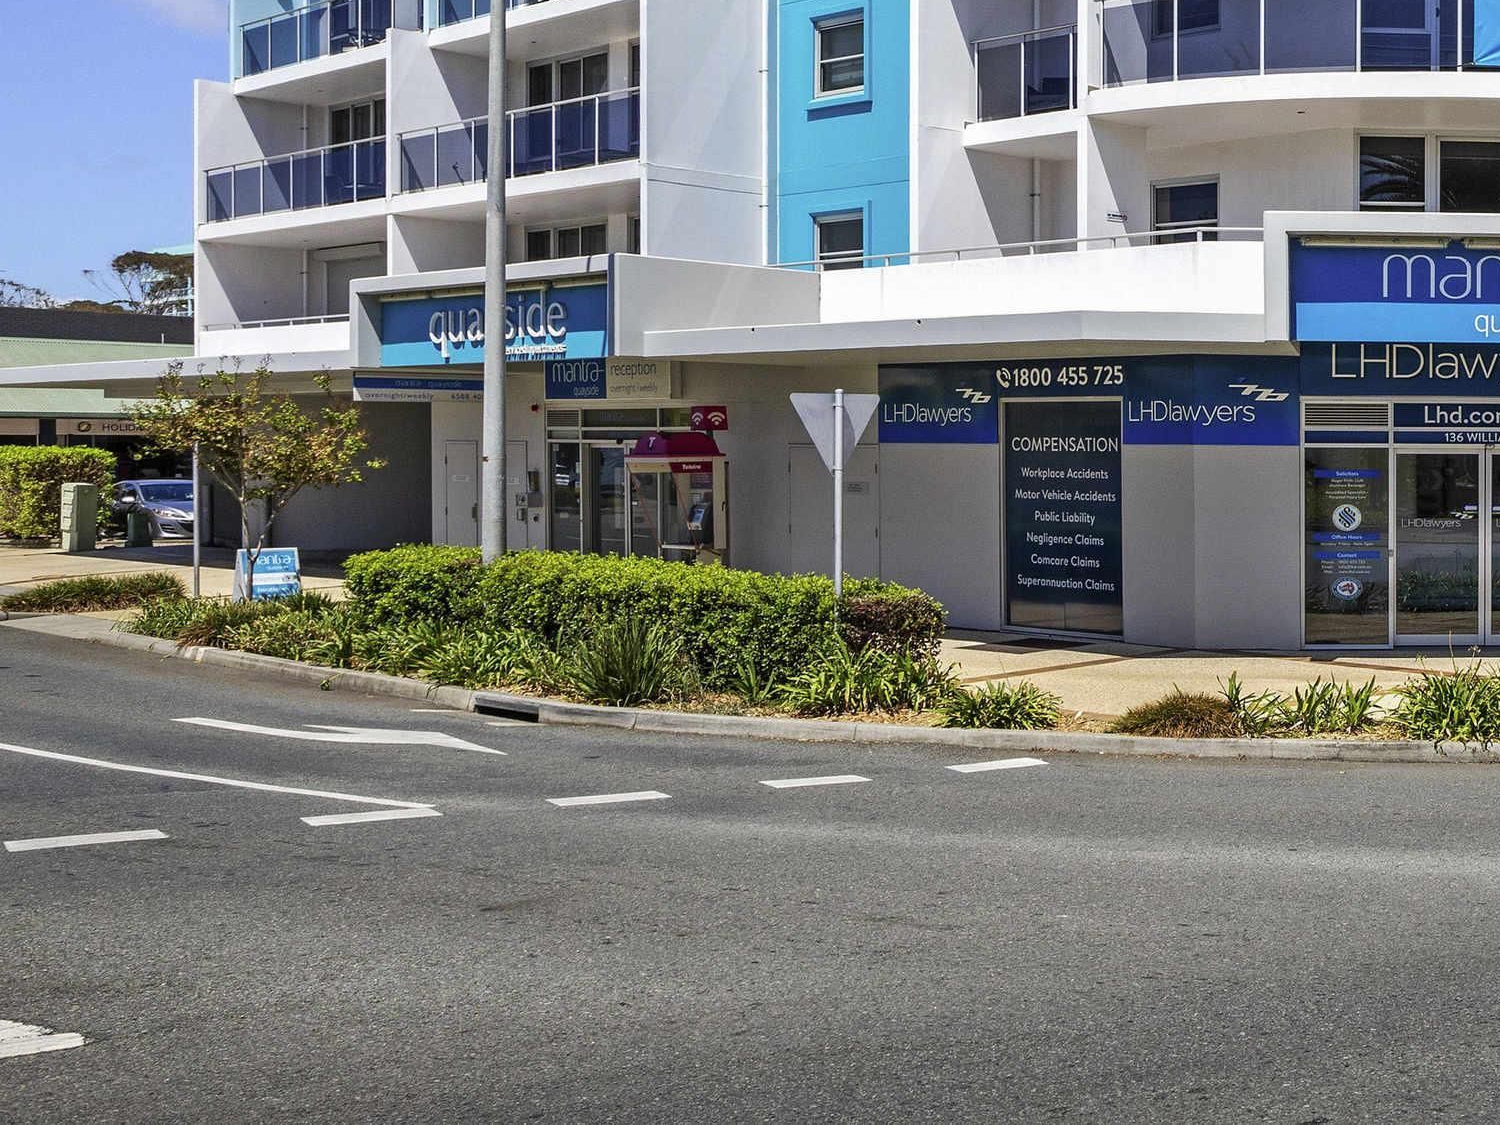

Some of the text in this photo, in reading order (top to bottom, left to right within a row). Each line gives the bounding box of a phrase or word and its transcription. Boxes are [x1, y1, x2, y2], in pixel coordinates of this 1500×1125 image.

[429, 289, 566, 358] quaside
[552, 361, 604, 382] mantra
[610, 362, 656, 379] reception
[1013, 365, 1124, 387] 1800 455 725
[574, 385, 600, 396] quayside
[884, 403, 972, 427] LHDlawyers
[1128, 399, 1256, 426] LHDlawyers
[102, 424, 147, 432] HOLIDA
[1011, 437, 1118, 452] COMPENSATION
[1445, 432, 1463, 443] 136
[1021, 467, 1109, 480] Workplace Accidents
[1015, 489, 1116, 502] Motor Vehicle Accidents
[1034, 510, 1095, 526] Public Liability
[1401, 518, 1462, 529] LHDlawyers
[1026, 532, 1104, 546] Negligence Claims
[1031, 553, 1100, 568] Comcare Claims
[1017, 574, 1115, 592] Superannuation Claims
